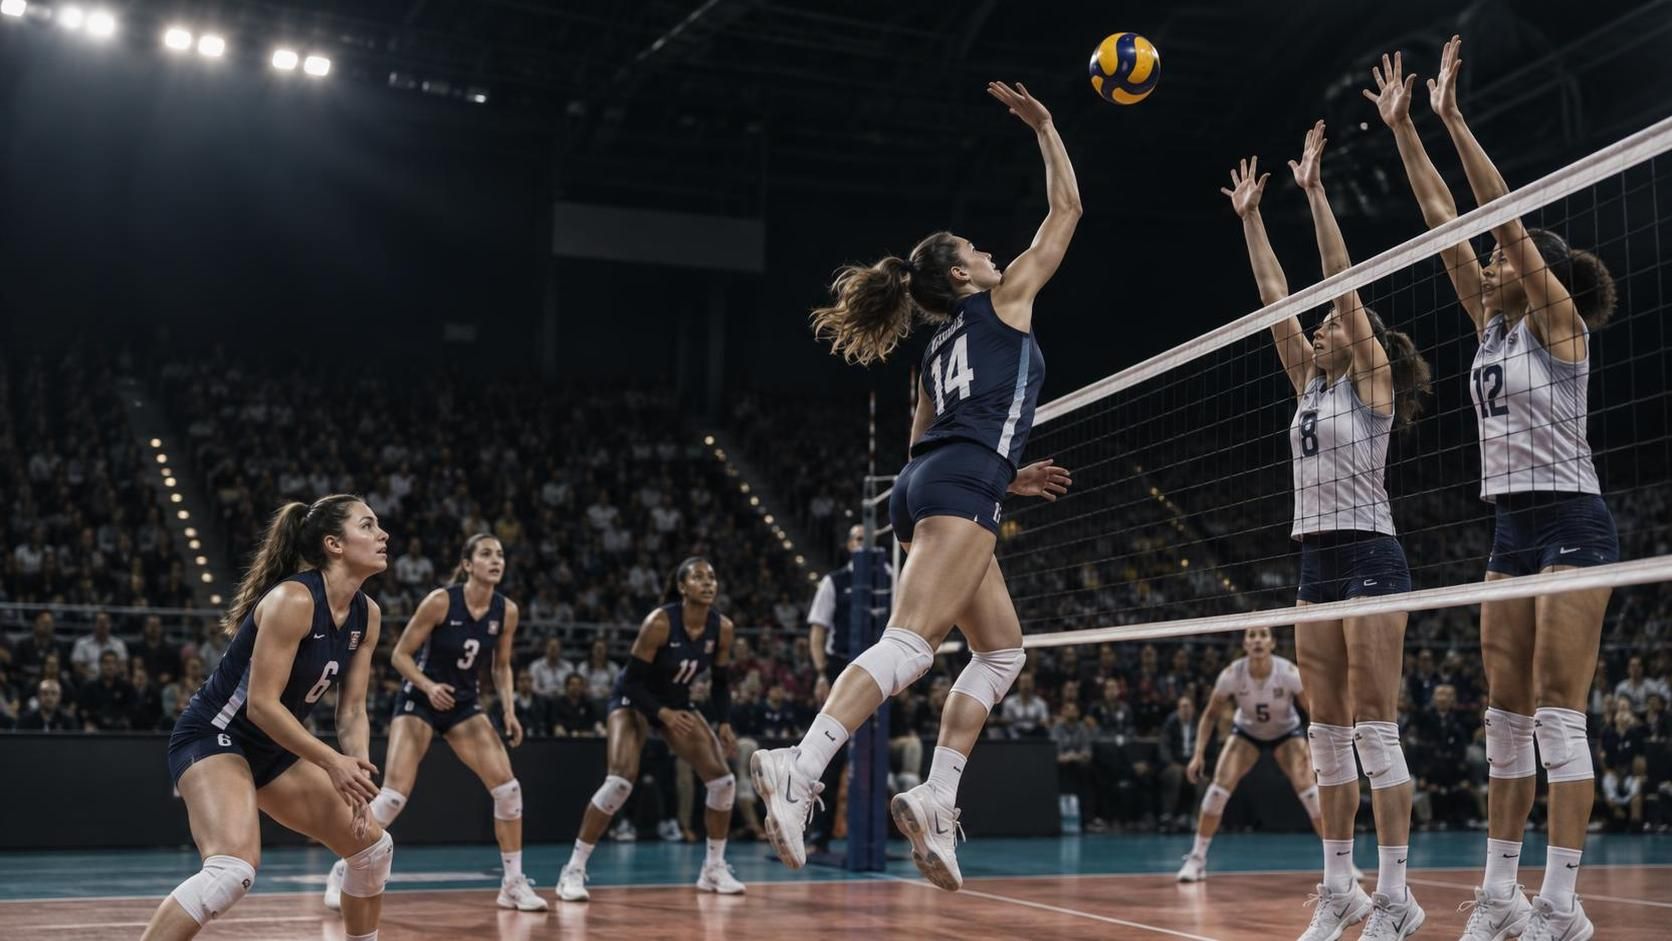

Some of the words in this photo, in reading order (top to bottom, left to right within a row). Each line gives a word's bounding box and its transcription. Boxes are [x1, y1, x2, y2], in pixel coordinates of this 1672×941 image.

[931, 333, 974, 416] 14
[1473, 364, 1509, 419] 12
[1301, 411, 1318, 457] 8
[457, 639, 480, 669] 3
[673, 659, 698, 684] 11
[305, 660, 339, 703] 6
[1256, 703, 1270, 722] 5
[217, 733, 232, 747] 6
